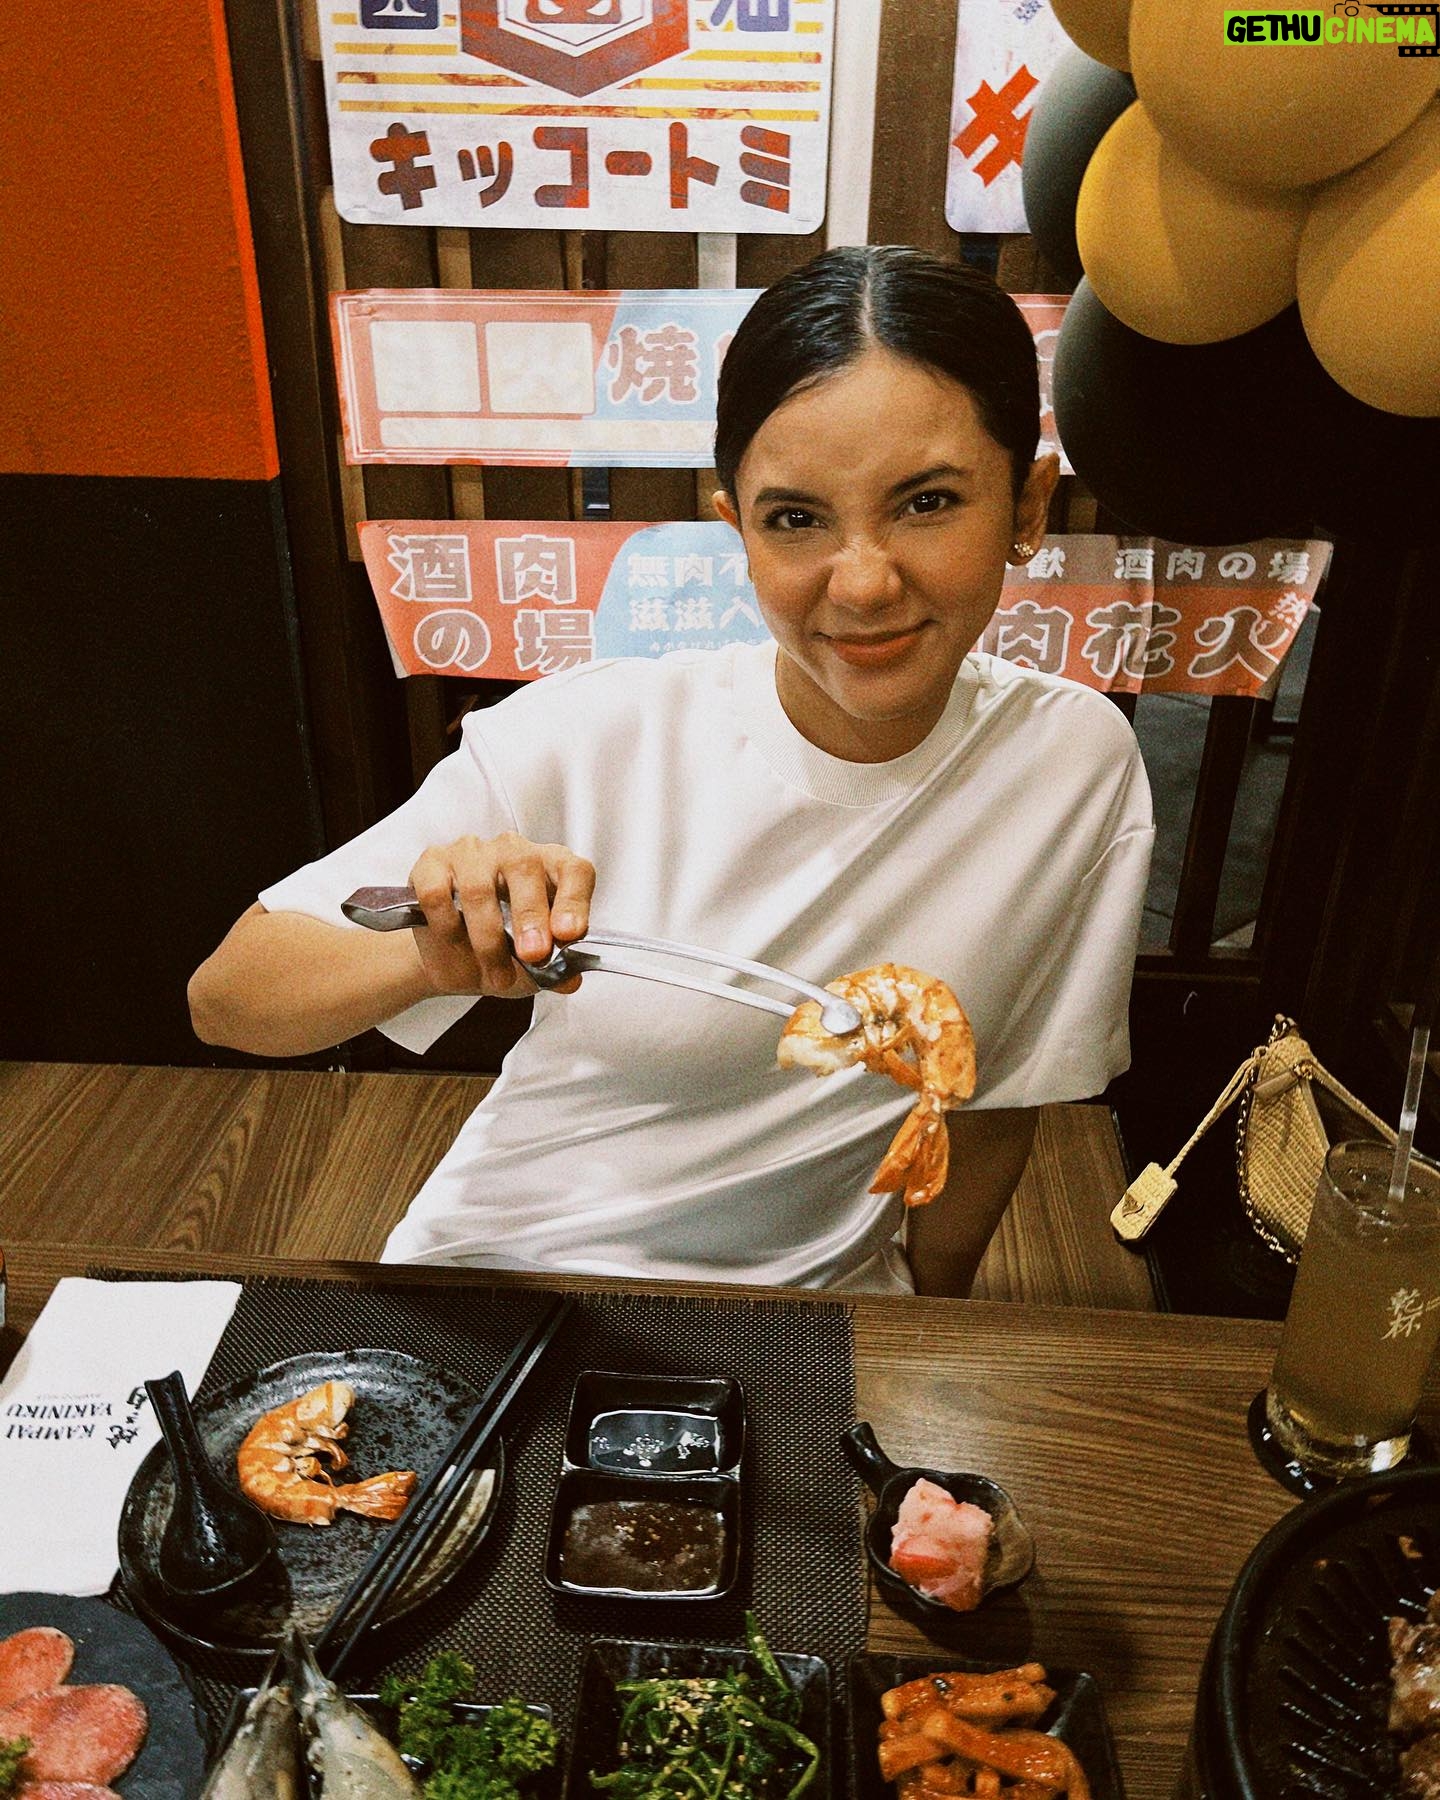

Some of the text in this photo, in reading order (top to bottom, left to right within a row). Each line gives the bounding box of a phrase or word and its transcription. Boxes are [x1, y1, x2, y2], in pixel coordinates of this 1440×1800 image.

[369, 121, 790, 214] キッコートミ
[607, 323, 734, 407] 焼
[1113, 547, 1310, 585] 酒肉の場
[5, 1403, 113, 1420] YAKINIKU
[5, 1423, 95, 1441] KAMPAI
